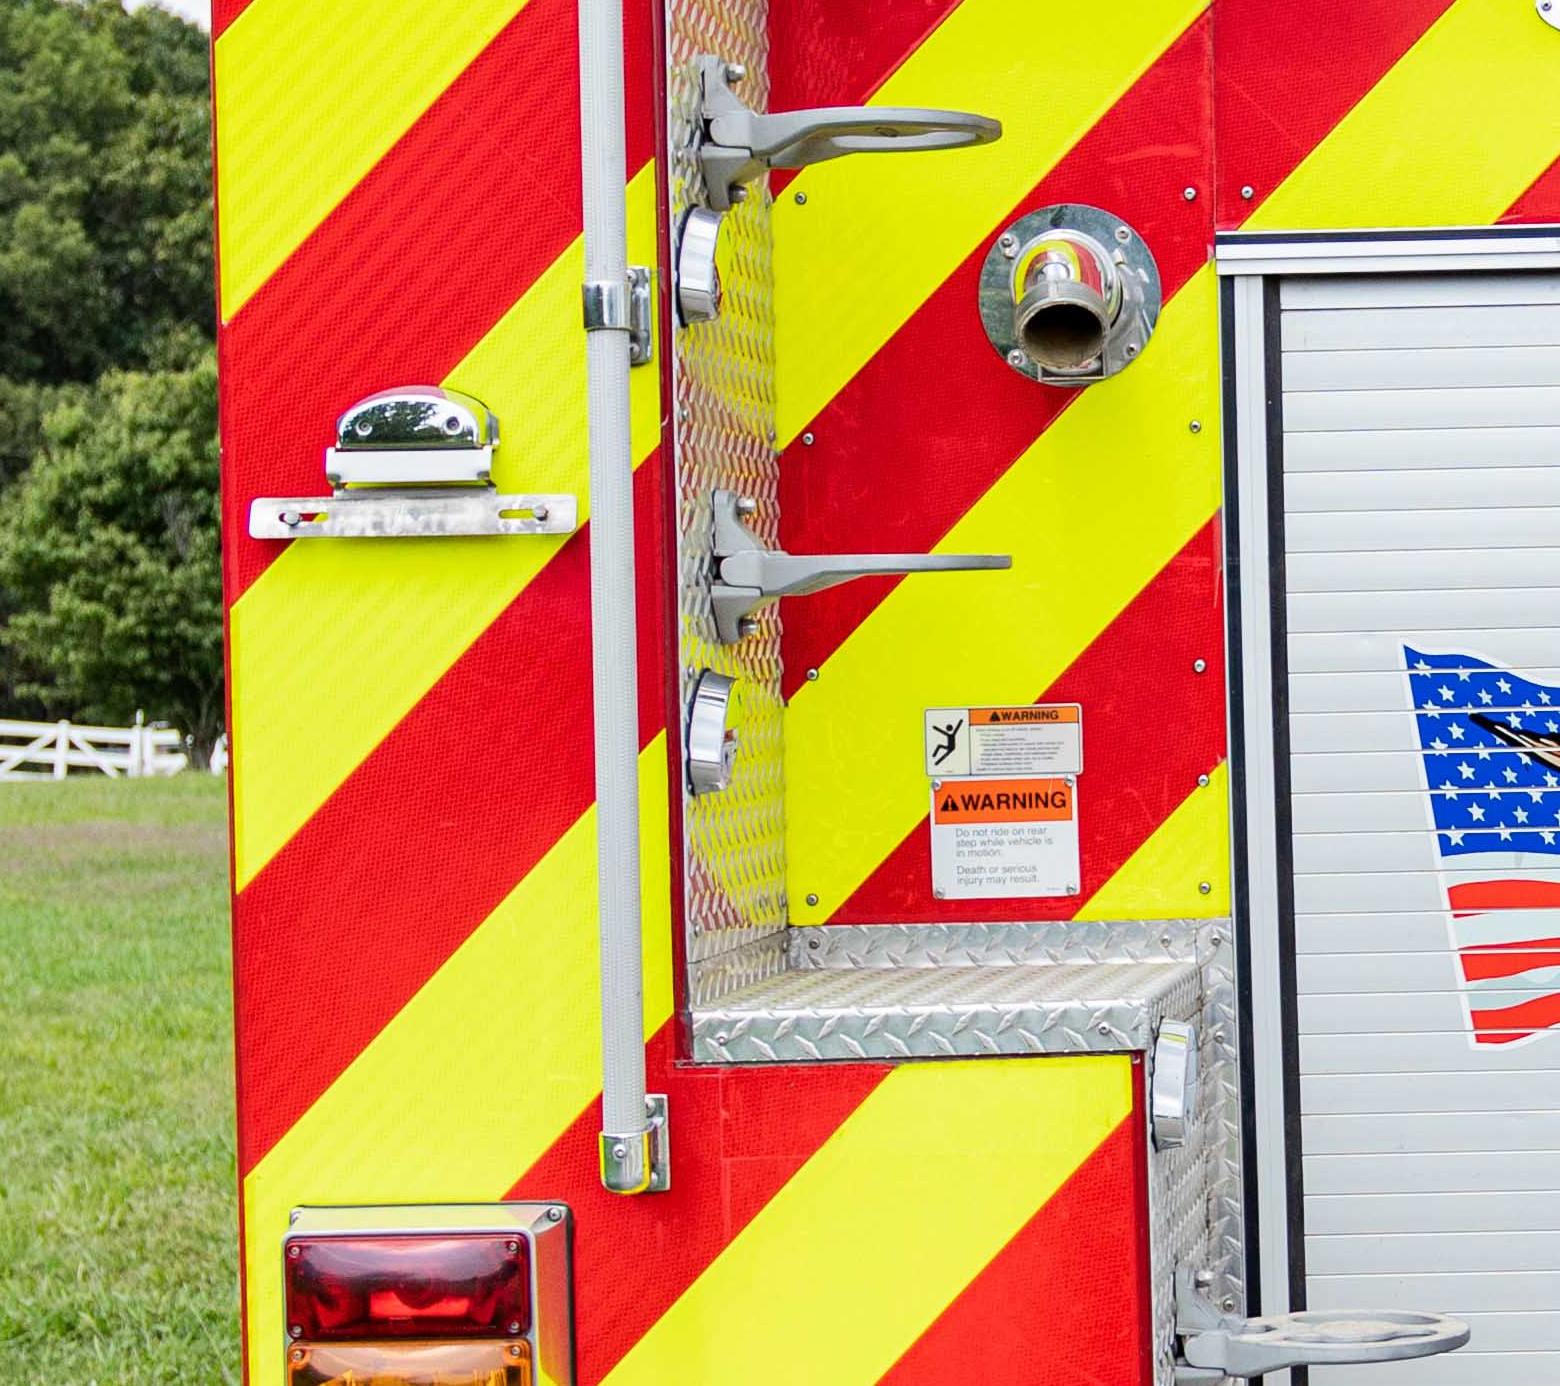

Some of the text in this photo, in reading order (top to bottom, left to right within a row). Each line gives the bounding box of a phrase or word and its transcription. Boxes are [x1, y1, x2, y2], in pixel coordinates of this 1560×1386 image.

[1000, 710, 1059, 722] WARNING
[960, 791, 1066, 811] WARNING
[955, 828, 969, 837] Do
[1027, 827, 1047, 835] rear
[956, 839, 976, 847] step
[1008, 837, 1041, 846] vehicle
[957, 866, 986, 874] Death
[1002, 865, 1037, 874] serious
[957, 876, 983, 886] injury
[986, 877, 1007, 885] may
